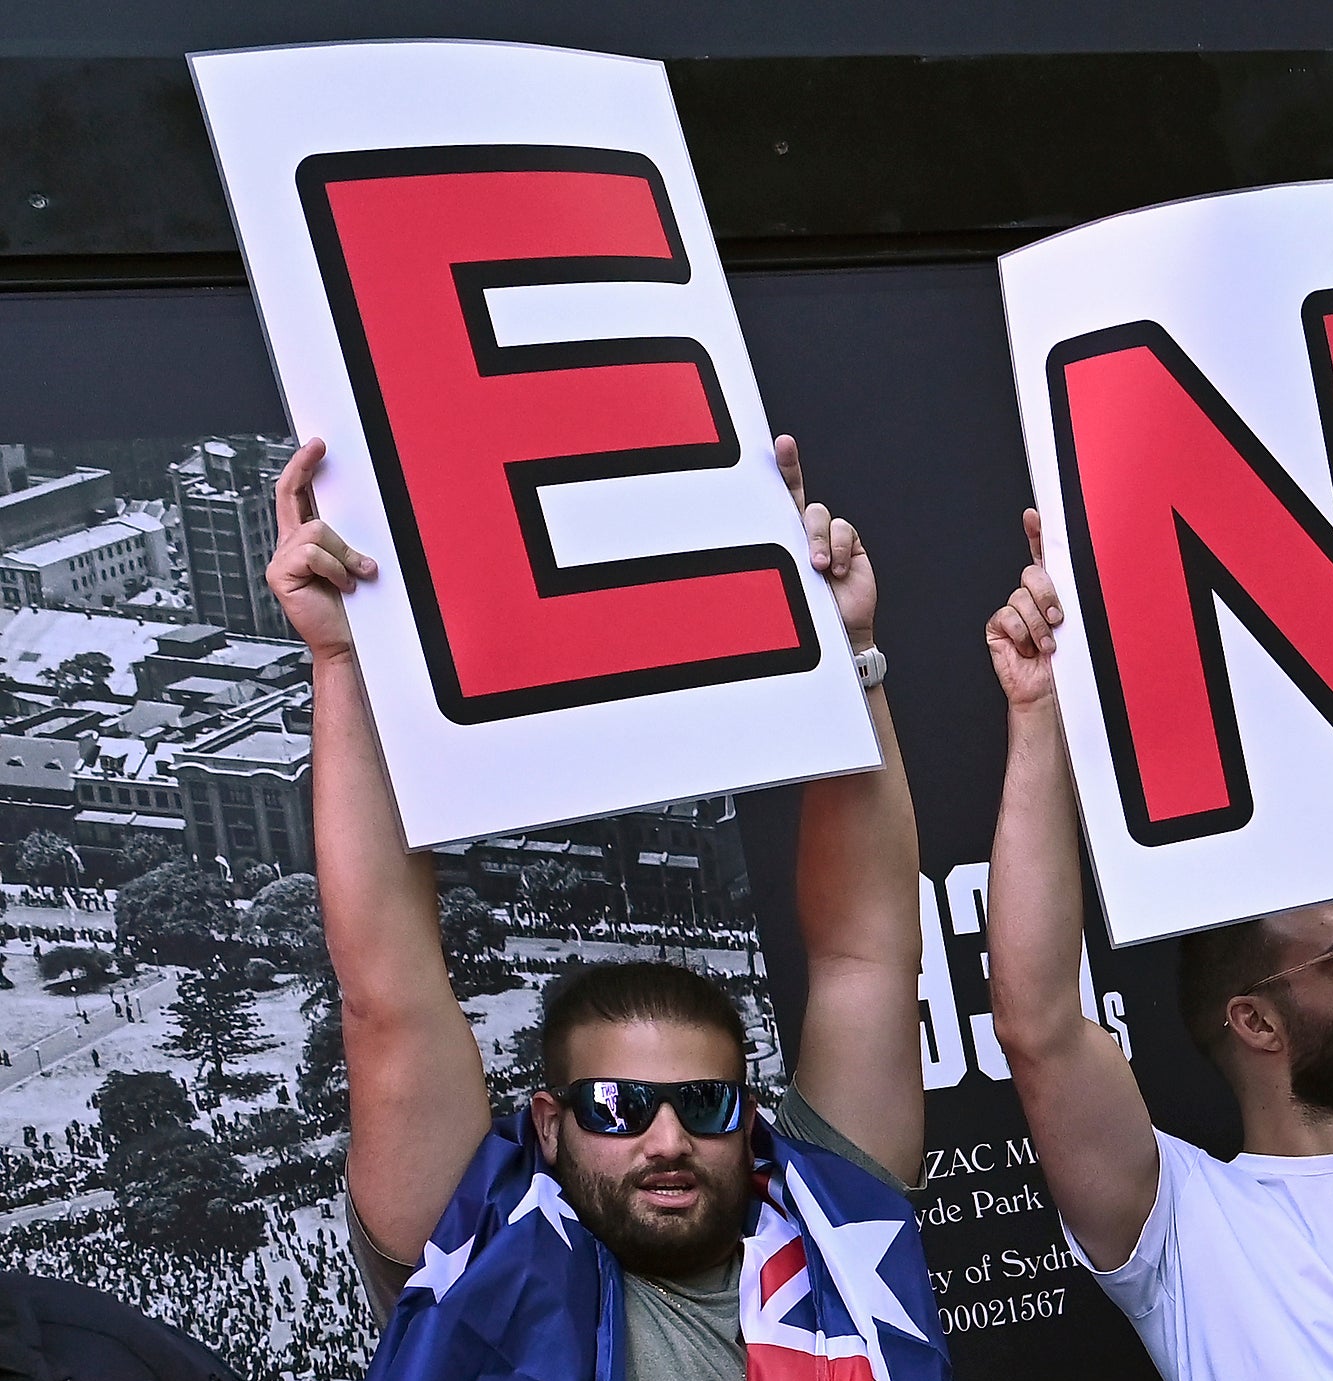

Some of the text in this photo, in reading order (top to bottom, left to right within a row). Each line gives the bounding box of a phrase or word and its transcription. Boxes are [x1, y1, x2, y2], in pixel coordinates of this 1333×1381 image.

[926, 1143, 995, 1180] ZAC
[914, 1184, 1045, 1232] yde Park
[927, 1243, 1079, 1294] ty of Sydn
[938, 1288, 1066, 1335] 00021567
